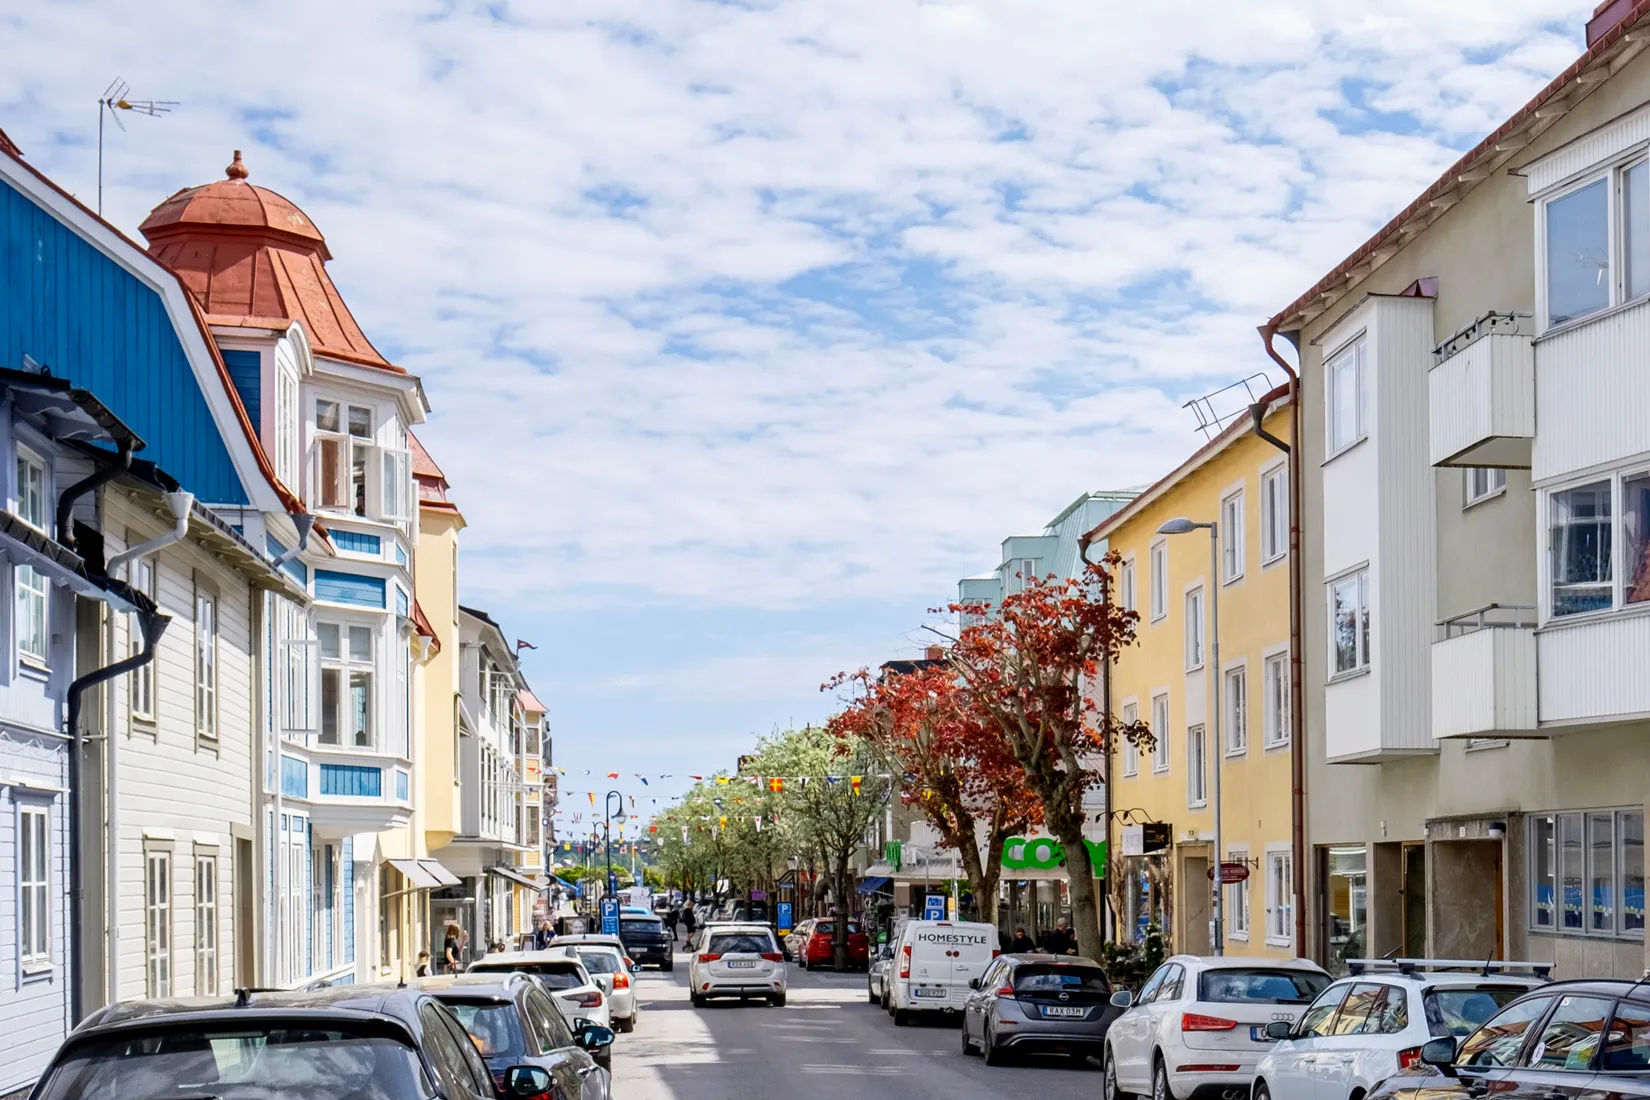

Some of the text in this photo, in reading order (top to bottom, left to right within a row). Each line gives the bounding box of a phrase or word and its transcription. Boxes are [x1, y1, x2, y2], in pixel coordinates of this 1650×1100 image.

[605, 904, 614, 916] P
[782, 905, 788, 914] P
[931, 911, 940, 920] P
[918, 933, 987, 945] HOMESTYLE
[1049, 1007, 1063, 1015] RAX
